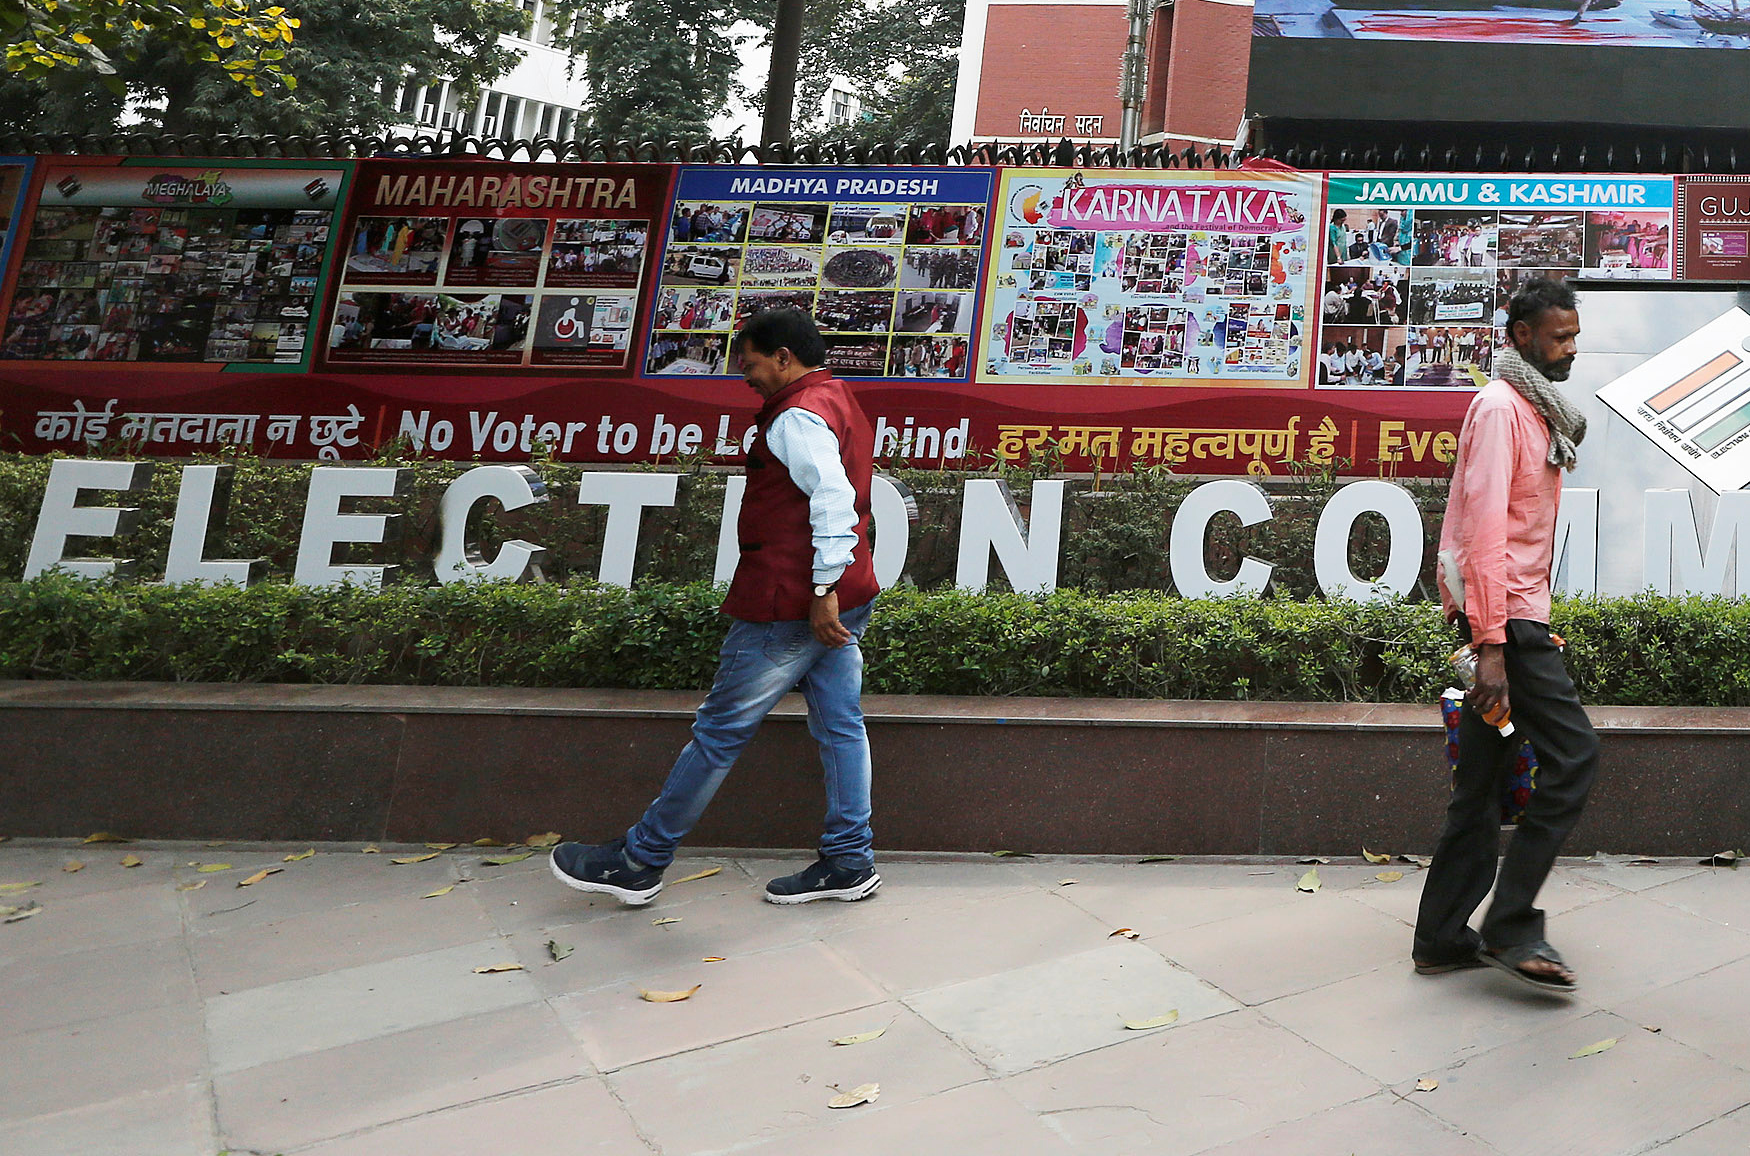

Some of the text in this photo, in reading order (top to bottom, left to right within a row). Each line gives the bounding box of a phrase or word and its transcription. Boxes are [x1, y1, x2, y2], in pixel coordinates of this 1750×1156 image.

[1019, 106, 1104, 137] निर्वाचन सदन
[148, 182, 227, 197] MEGHALAYA
[374, 175, 638, 210] MAHARASHTRA
[730, 177, 938, 196] MADHYA PRADESH
[1355, 182, 1646, 206] JAMMU & KASHMIR
[1061, 188, 1285, 224] KARNATAKA
[35, 399, 365, 460] कोई मतदाता न छूटे
[400, 409, 757, 456] No Voter to be Le
[998, 416, 1339, 475] हर मत महत्वपूर्ण है
[1378, 421, 1457, 462] Eve
[1711, 433, 1749, 459] ELECTION
